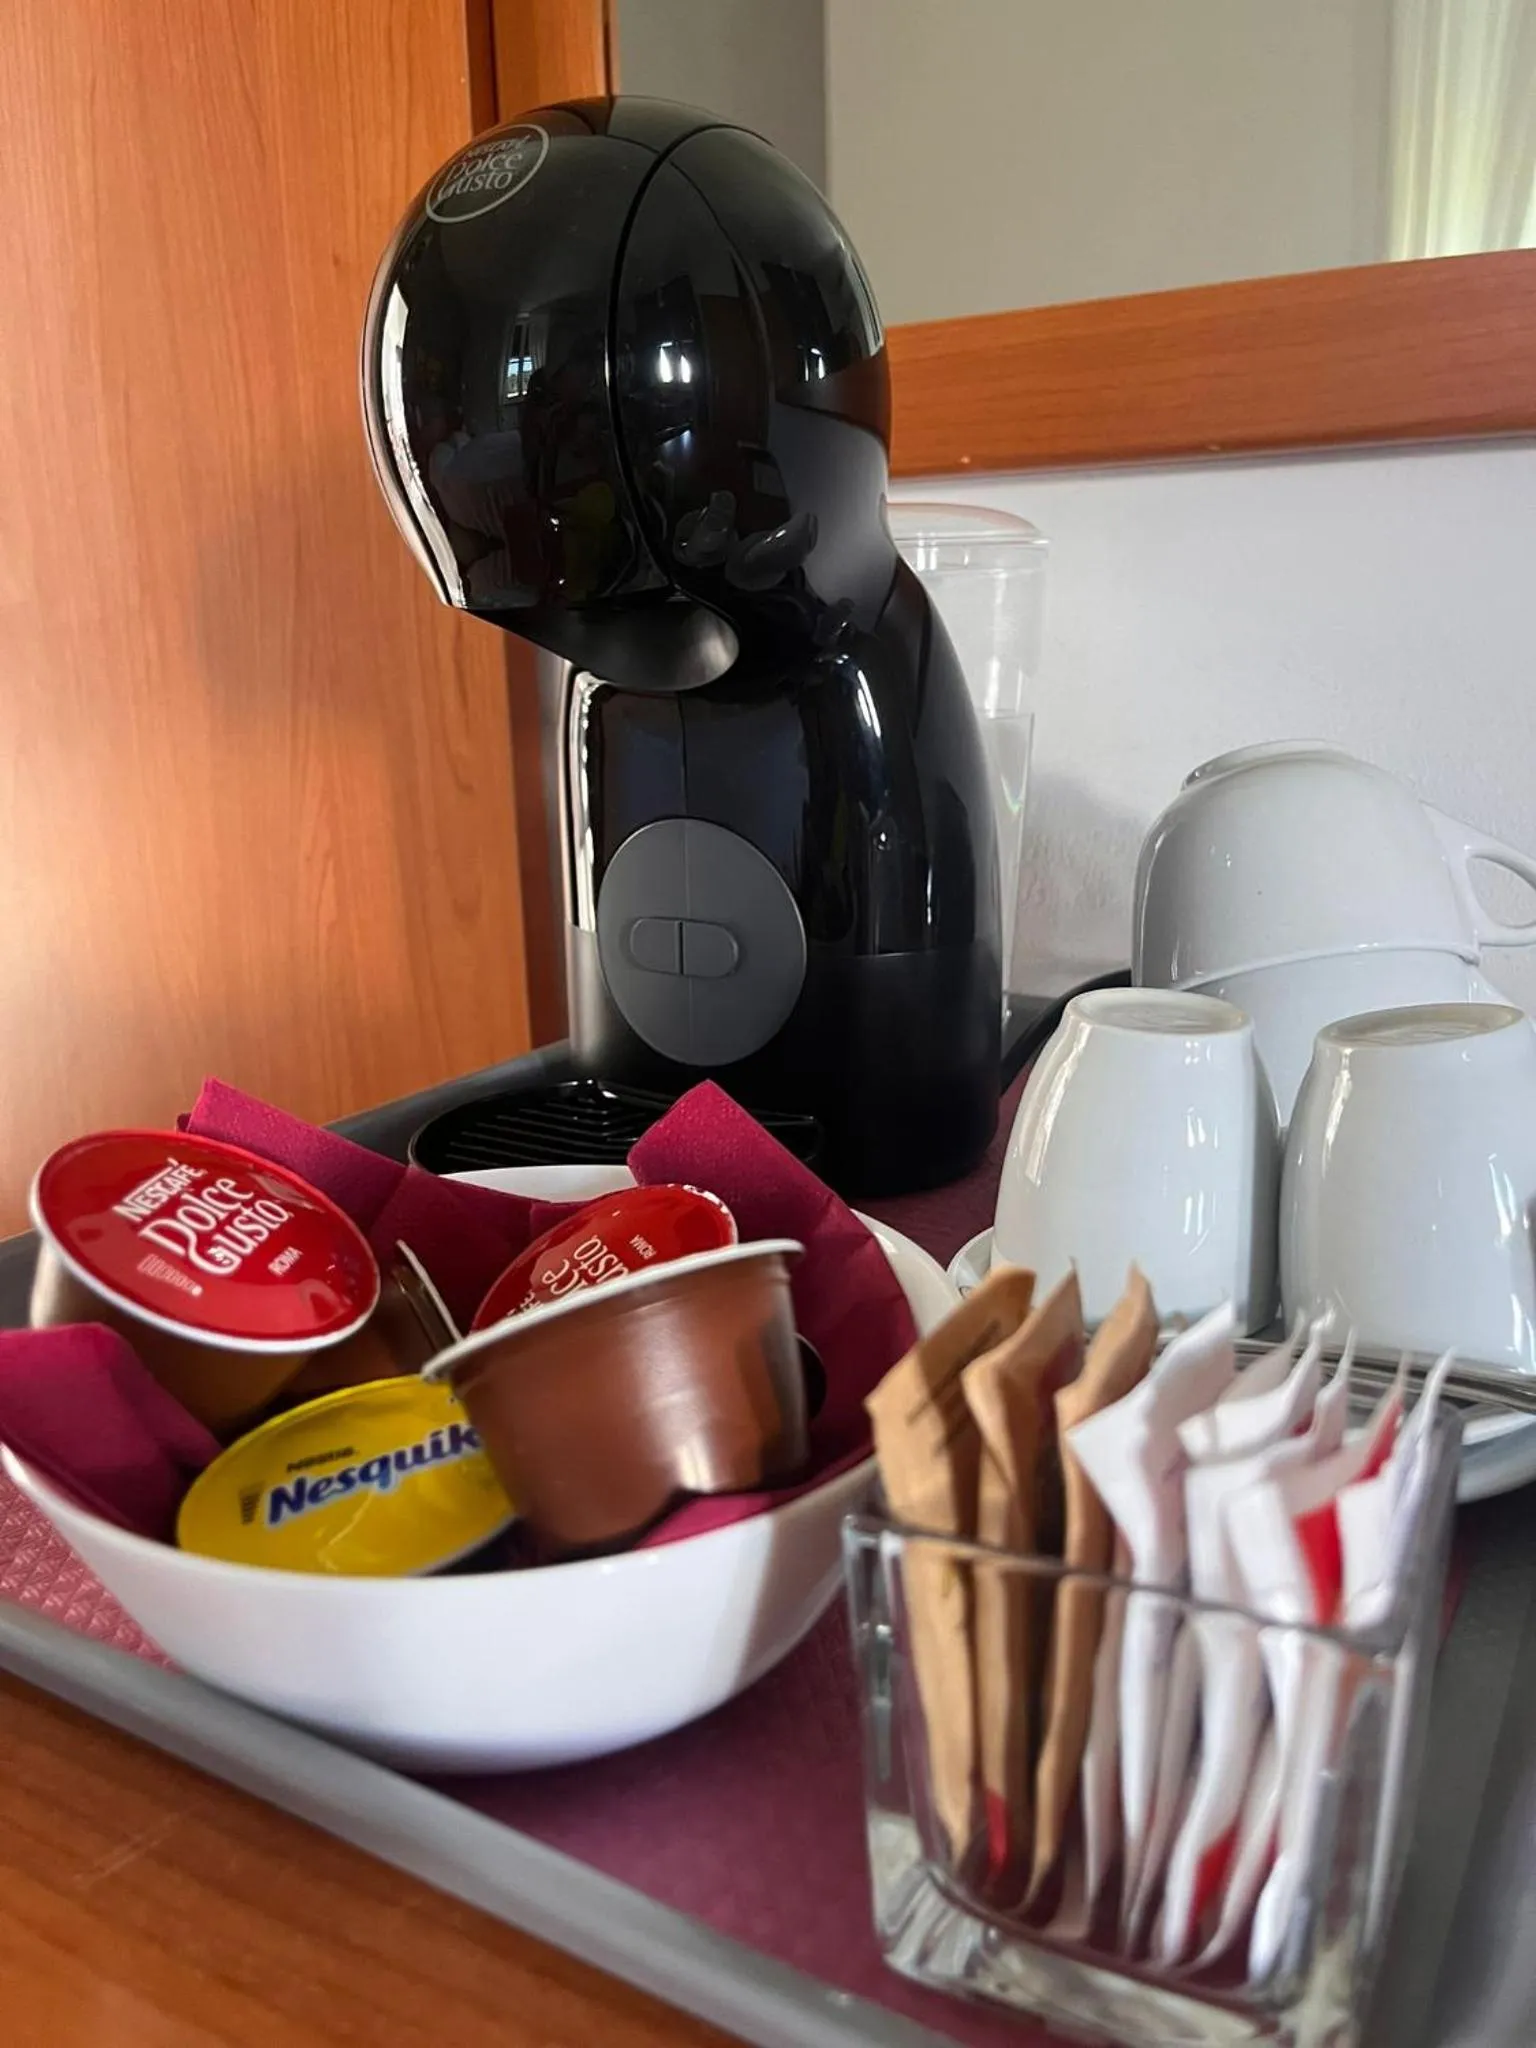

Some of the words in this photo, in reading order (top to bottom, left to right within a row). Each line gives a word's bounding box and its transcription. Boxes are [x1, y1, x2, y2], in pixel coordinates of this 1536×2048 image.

[438, 170, 513, 202] Gusto
[445, 152, 523, 183] Dolce
[138, 1177, 254, 1256] Dolce
[188, 1199, 290, 1276] Gusto
[629, 1234, 656, 1260] ROMA
[268, 1246, 302, 1277] ROMA
[573, 1237, 630, 1284] usto
[266, 1423, 482, 1526] Nesquik
